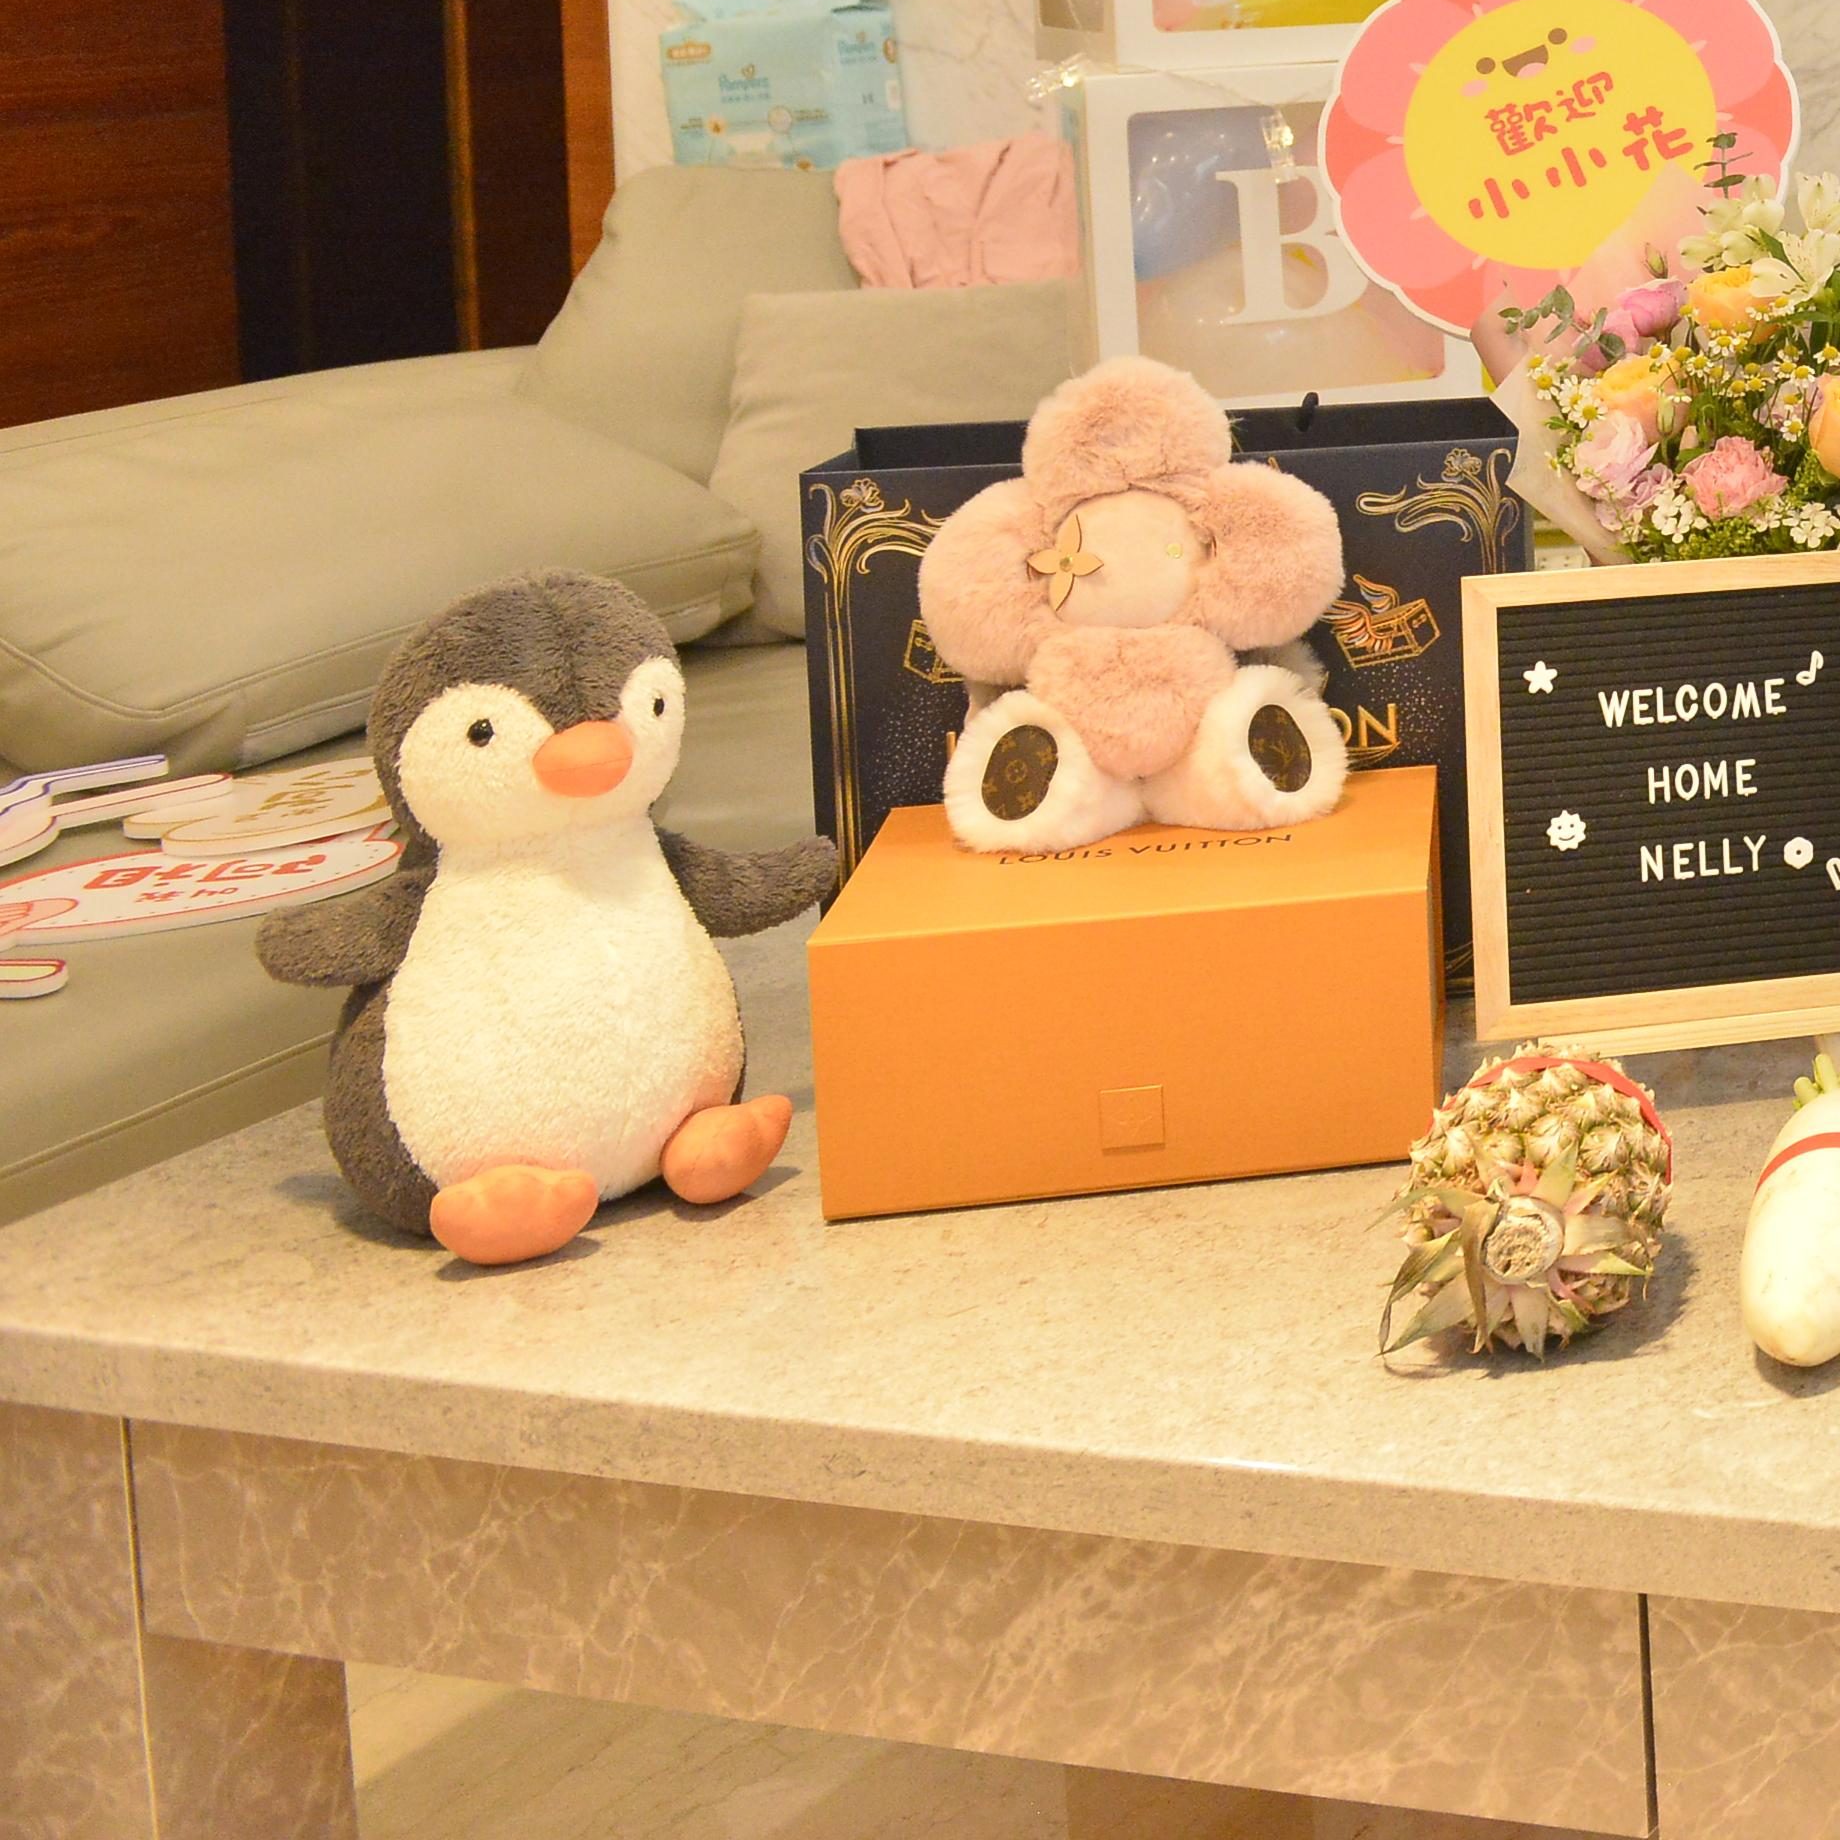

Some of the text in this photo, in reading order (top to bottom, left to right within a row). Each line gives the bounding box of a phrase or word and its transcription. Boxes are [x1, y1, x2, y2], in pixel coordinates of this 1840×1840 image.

[1484, 71, 1615, 157] 歡迎
[1467, 106, 1694, 220] 小小花
[1598, 678, 1787, 729] WELCOME
[1646, 758, 1759, 806] HOME
[999, 833, 1292, 865] LOUIS VUITTON
[1639, 834, 1767, 883] NELLY
